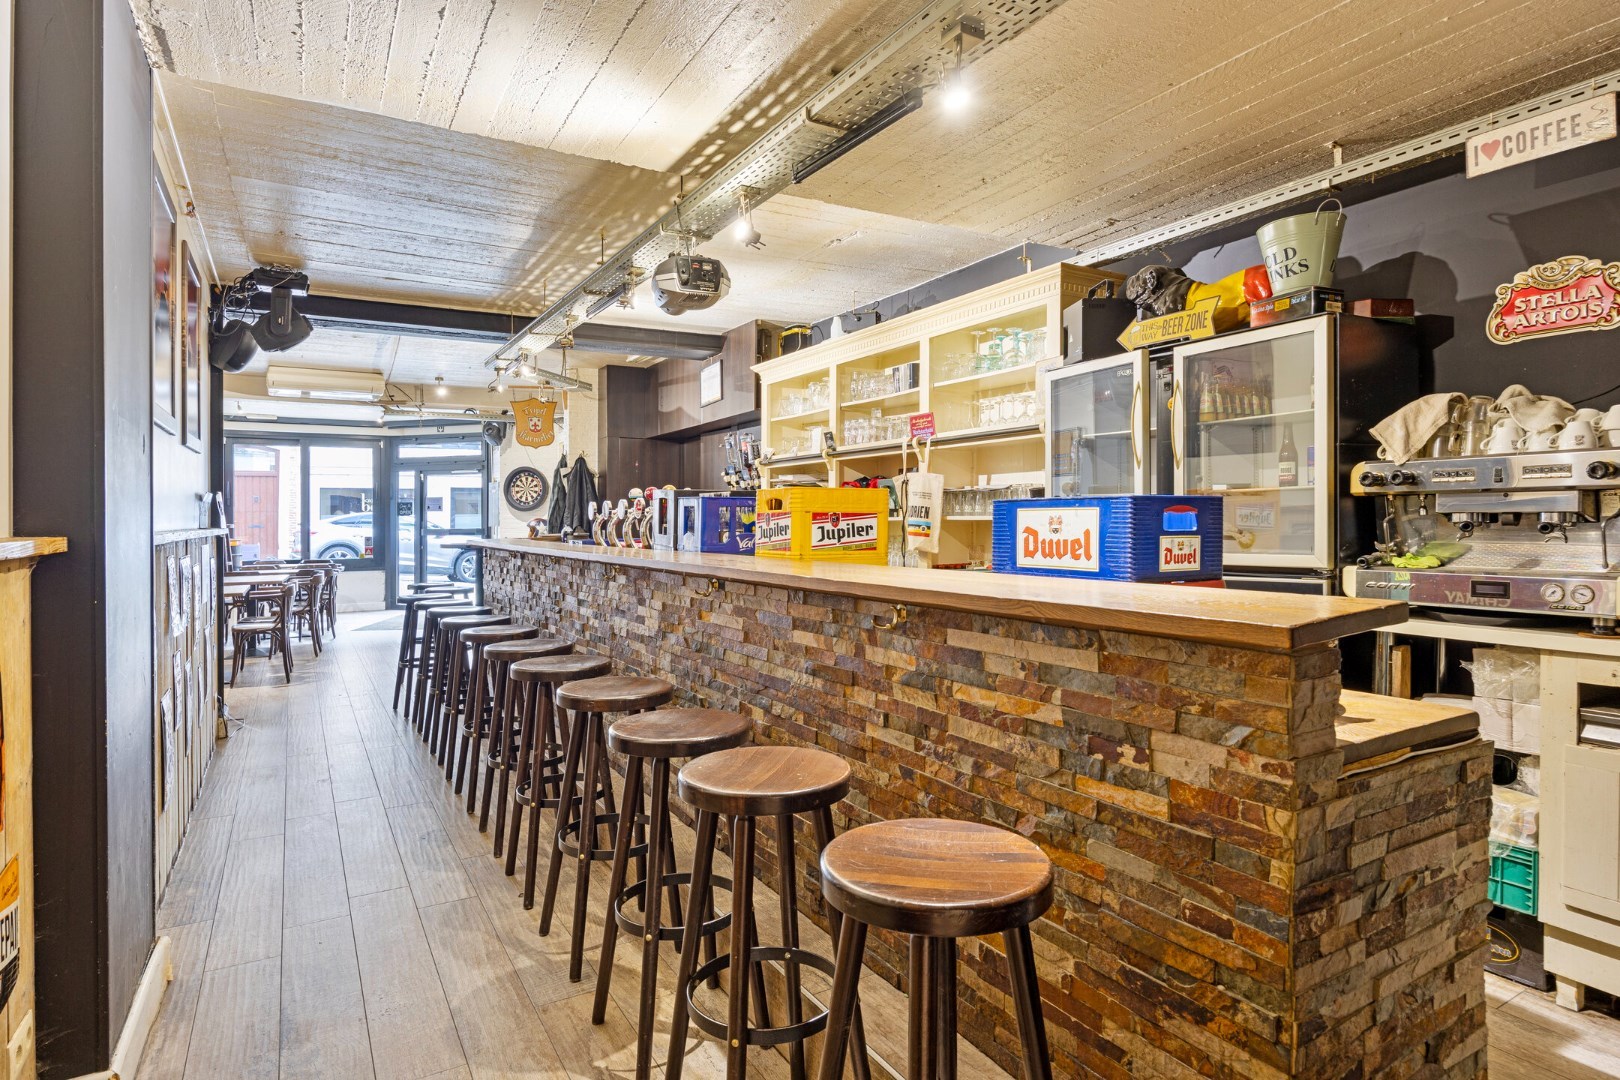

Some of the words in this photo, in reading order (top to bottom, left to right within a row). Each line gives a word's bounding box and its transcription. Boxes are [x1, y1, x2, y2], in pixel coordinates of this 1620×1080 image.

[1473, 145, 1479, 167] I
[1502, 113, 1582, 158] COFFEE
[1514, 285, 1604, 313] STELLA
[1142, 321, 1159, 332] THIS
[1162, 316, 1184, 337] BEER
[1185, 310, 1209, 333] ZONE
[1512, 302, 1604, 328] ARTOIS
[1141, 331, 1158, 342] WAY
[758, 522, 790, 542] Jupiler
[816, 522, 874, 543] Jupiler
[1022, 525, 1093, 562] Duvel
[1163, 547, 1197, 565] Duvel
